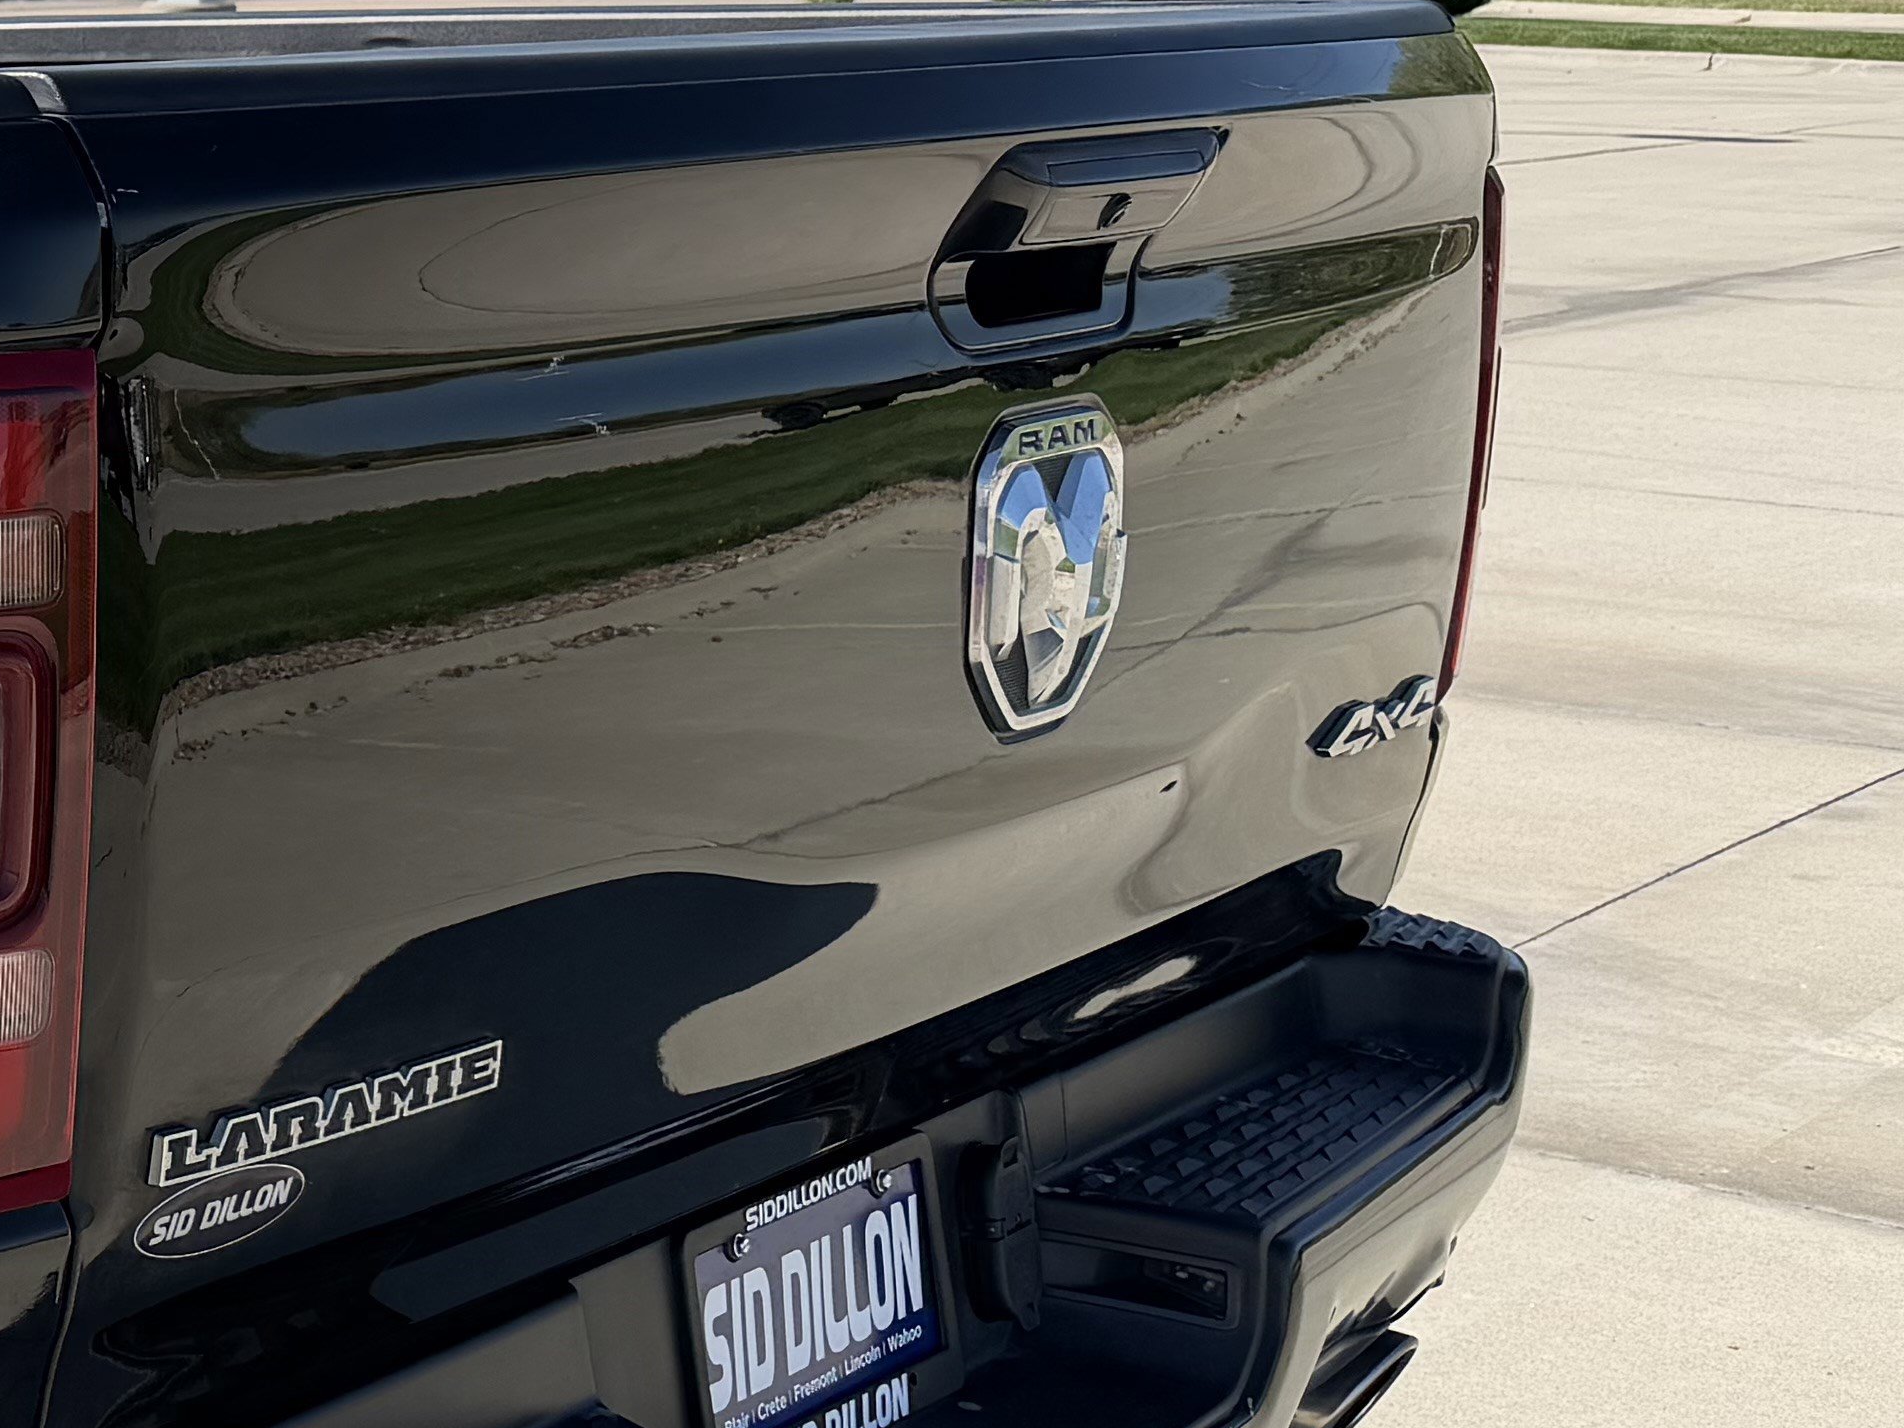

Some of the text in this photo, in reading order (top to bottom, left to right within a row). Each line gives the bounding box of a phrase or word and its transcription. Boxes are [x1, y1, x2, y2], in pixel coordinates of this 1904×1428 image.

[1017, 418, 1099, 460] RAM
[152, 1038, 504, 1187] LARAMIE
[148, 1176, 294, 1247] SID DILLON
[744, 1156, 873, 1232] SIDDILLON.COM
[703, 1193, 924, 1415] SID DILLON
[757, 1394, 788, 1422] Crete
[793, 1365, 838, 1401] Fremont
[844, 1344, 882, 1377] Lincoln
[886, 1323, 923, 1353] Wahoo
